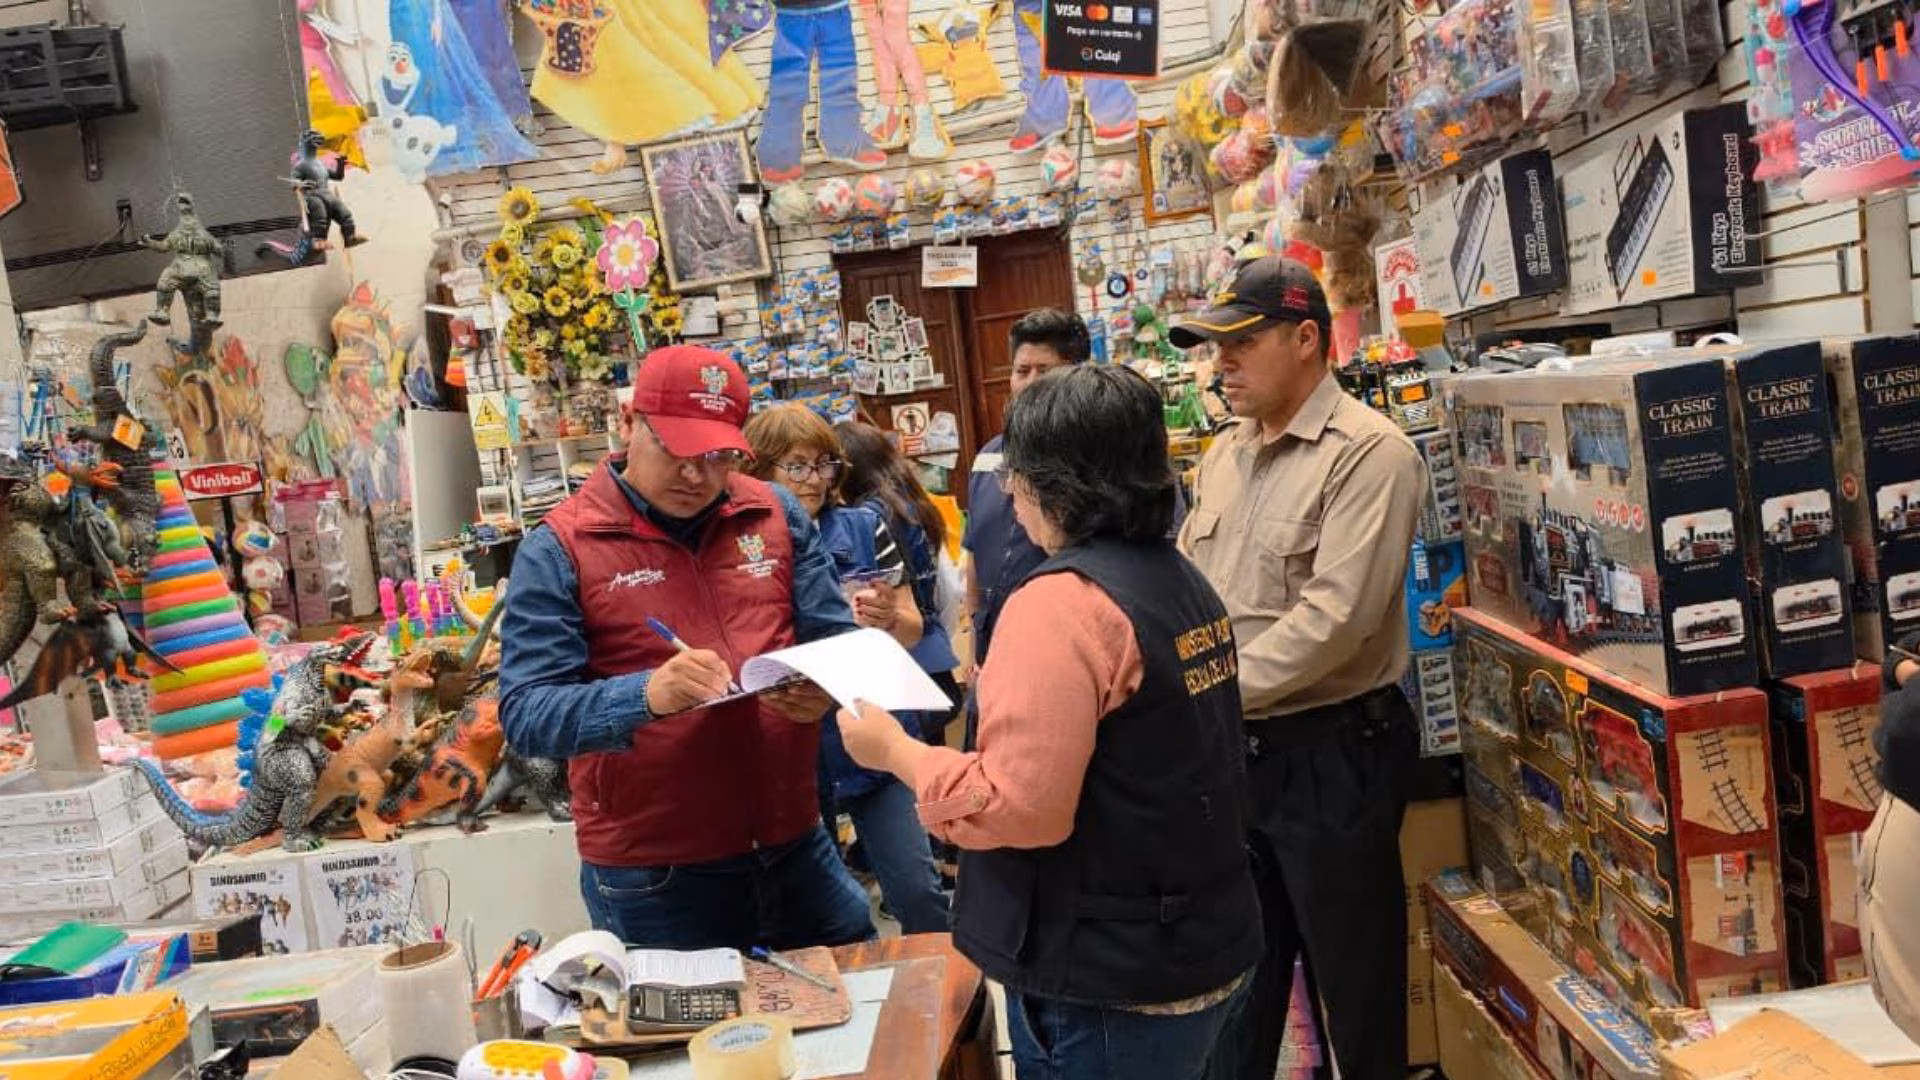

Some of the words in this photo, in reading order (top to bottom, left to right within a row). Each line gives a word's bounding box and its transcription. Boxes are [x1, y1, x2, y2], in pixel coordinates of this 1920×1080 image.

[1055, 4, 1082, 17] VISA
[1095, 49, 1121, 65] Culqi
[1723, 133, 1744, 198] Keyboard
[1711, 212, 1729, 246] Keys
[1728, 197, 1746, 264] Electronic
[1747, 379, 1815, 402] CLASSIC
[1648, 397, 1717, 420] CLASSIC
[1759, 395, 1811, 417] TRAIN
[1660, 413, 1713, 434] TRAIN
[190, 470, 252, 488] Viniball
[322, 855, 380, 873] DINOSAURIO
[209, 871, 267, 887] DINOSAURIO
[345, 908, 384, 924] 38.00
